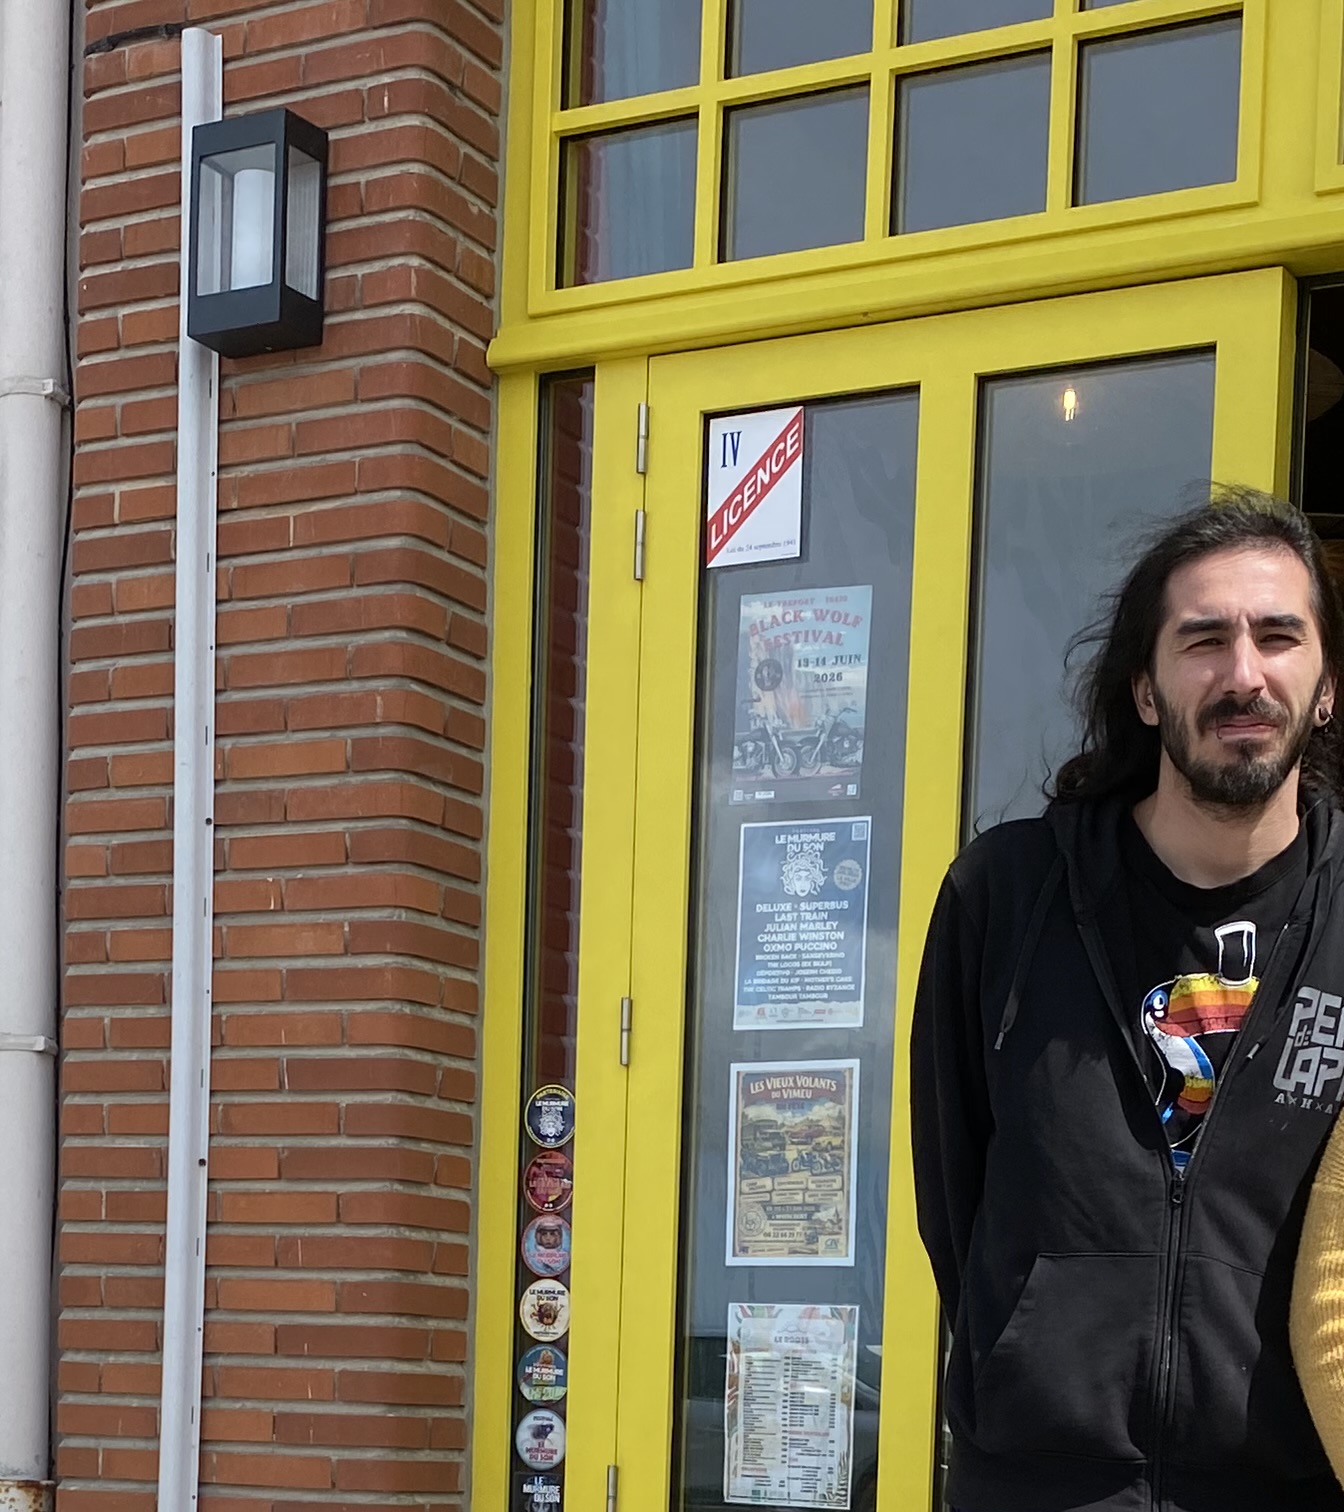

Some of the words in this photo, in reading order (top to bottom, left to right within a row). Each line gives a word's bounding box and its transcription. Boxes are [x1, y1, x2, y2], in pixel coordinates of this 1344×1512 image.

[720, 430, 743, 468] IV
[710, 421, 800, 551] LICENCE
[749, 610, 806, 637] BLACK
[813, 608, 864, 628] WOLF
[763, 629, 844, 652] FESTIVAL
[832, 654, 862, 666] JUIN
[813, 672, 843, 683] 2026
[775, 834, 787, 844] LE
[787, 832, 836, 843] MURMURE
[787, 843, 801, 853] DU
[803, 842, 824, 852] SON
[756, 903, 792, 913] DELUXE
[799, 901, 848, 911] SUPERBUS
[775, 912, 798, 922] LAST
[800, 911, 828, 921] TRAIN
[764, 922, 796, 932] JULIAN
[799, 921, 838, 931] MARLEY
[757, 933, 796, 943] CHARLIE
[799, 931, 844, 941] WINSTON
[763, 943, 792, 952] OXMO
[794, 942, 837, 951] PUCCINO
[750, 1081, 765, 1094] LES
[766, 1076, 795, 1090] VIEUX
[796, 1075, 837, 1092] VOLANTS
[782, 1089, 813, 1099] VIMEU
[534, 1476, 544, 1485] LE
[522, 1484, 561, 1493] MURMURE
[534, 1493, 544, 1503] DU
[545, 1493, 560, 1503] SON
